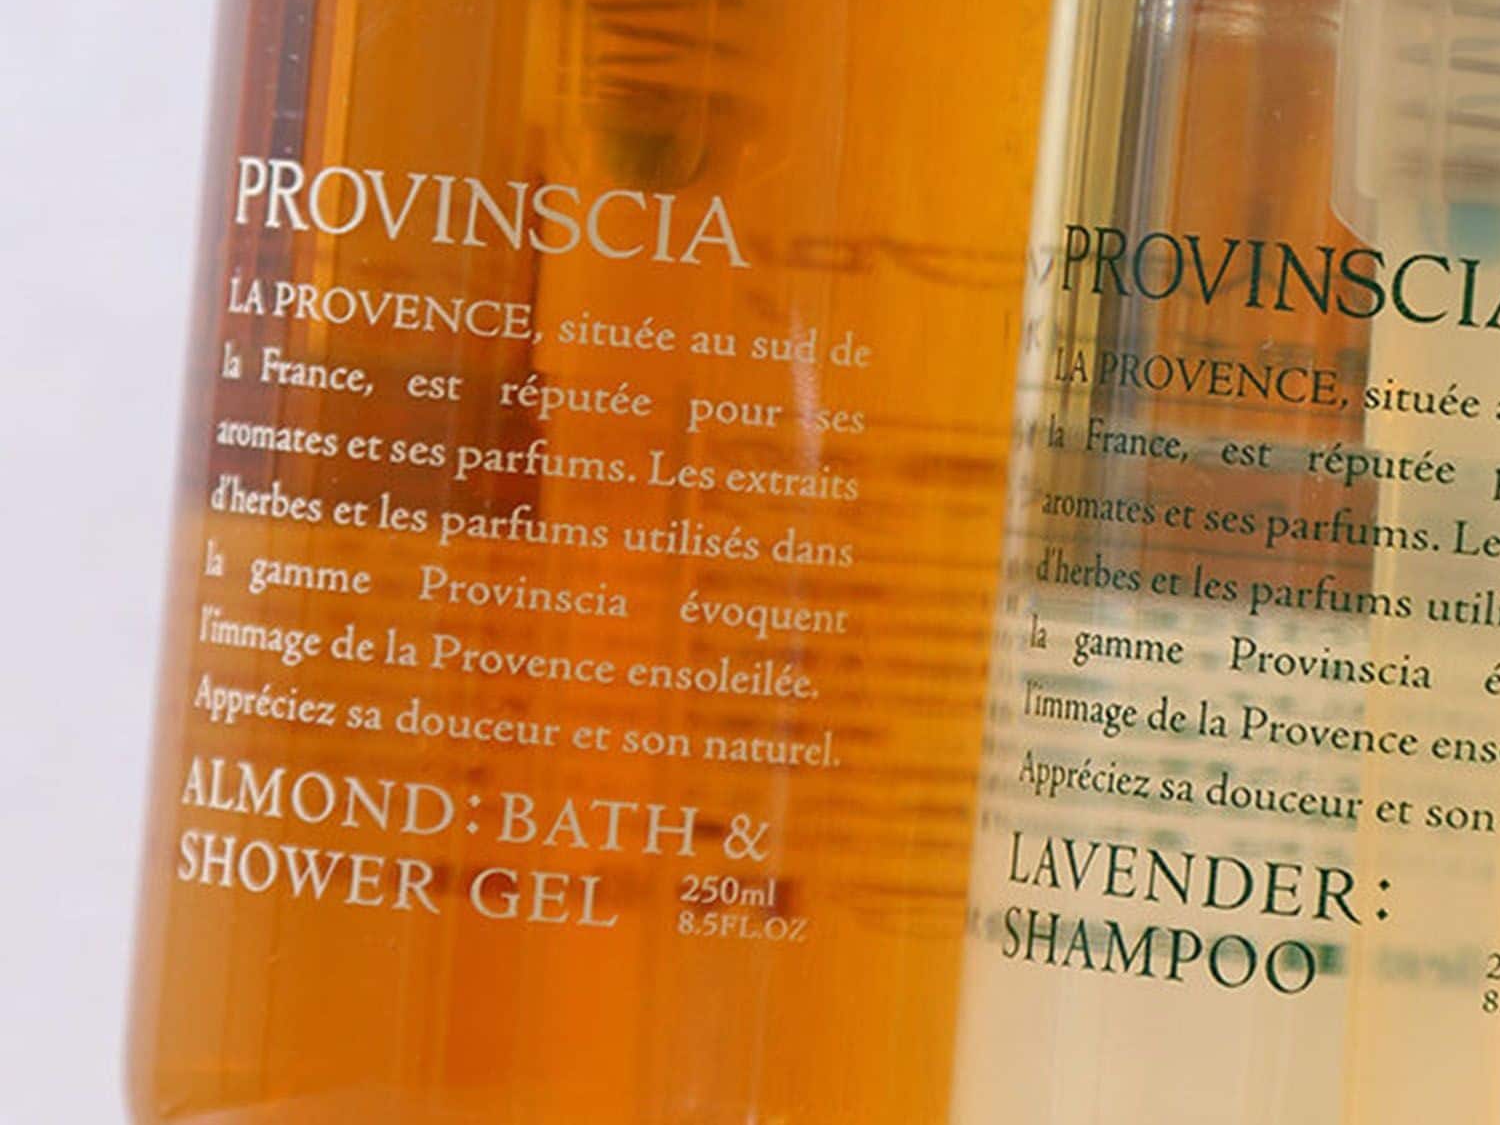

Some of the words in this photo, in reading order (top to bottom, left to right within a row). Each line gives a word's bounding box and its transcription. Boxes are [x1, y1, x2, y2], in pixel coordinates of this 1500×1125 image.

[234, 155, 752, 269] PROVINSCIA
[228, 277, 263, 317] LA
[272, 282, 543, 344] PROVENCE,
[557, 314, 676, 351] située
[690, 327, 736, 356] au
[752, 327, 817, 364] sud
[830, 332, 871, 369] de
[221, 342, 241, 379] la
[260, 346, 374, 398] France,
[407, 373, 461, 402] est
[500, 373, 653, 420] réputée
[687, 397, 782, 433] pour
[817, 406, 865, 434] ses
[1054, 346, 1088, 384] LA
[1100, 351, 1349, 410] PROVENCE,
[1364, 378, 1480, 419] située
[216, 418, 338, 458] aromates
[346, 431, 383, 462] et
[391, 440, 445, 468] ses
[454, 440, 638, 484] parfums.
[647, 451, 716, 489] Les
[725, 470, 859, 502] extraits
[1048, 412, 1065, 448] la
[1085, 418, 1189, 465] France,
[1221, 440, 1271, 469] est
[1308, 441, 1455, 487] réputée
[333, 497, 368, 527] et
[377, 493, 427, 534] les
[440, 505, 609, 549] parfums
[623, 520, 760, 561] utilisés
[772, 528, 853, 567] dans
[1042, 488, 1155, 527] aromates
[1164, 500, 1198, 530] et
[1204, 507, 1255, 535] ses
[1265, 507, 1439, 552] parfums.
[204, 541, 223, 576] la
[248, 555, 370, 595] gamme
[419, 566, 628, 617] Provinscia
[680, 590, 848, 639] évoquent
[1150, 568, 1181, 596] et
[1193, 562, 1237, 601] les
[1250, 574, 1412, 618] parfums
[199, 605, 320, 666] l'immage
[330, 626, 374, 662] de
[384, 629, 417, 668] la
[430, 636, 614, 682] Provence
[628, 655, 819, 699] ensoleilée.
[1030, 614, 1047, 649] la
[1074, 626, 1183, 665] gamme
[1230, 636, 1431, 689] Provinscia
[195, 674, 336, 727] Appréciez
[346, 702, 382, 731] sa
[396, 701, 560, 748] douceur
[572, 722, 610, 752] et
[622, 728, 691, 759] son
[703, 731, 841, 768] naturel.
[1025, 681, 1136, 735] l'immage
[1148, 697, 1186, 732] de
[1198, 700, 1228, 739] la
[1240, 706, 1418, 755] Provence
[499, 793, 698, 857] BATH
[722, 813, 770, 862] &
[1019, 749, 1150, 799] Appréciez
[1159, 773, 1193, 803] sa
[1206, 774, 1363, 820] douceur
[1376, 797, 1411, 824] et
[1425, 802, 1494, 833] son
[178, 831, 441, 916] SHOWER
[469, 866, 619, 927] GEL
[680, 876, 775, 907] 250ml
[1008, 831, 1390, 925] LAVENDER:
[1001, 905, 1316, 994] SHAMPOO
